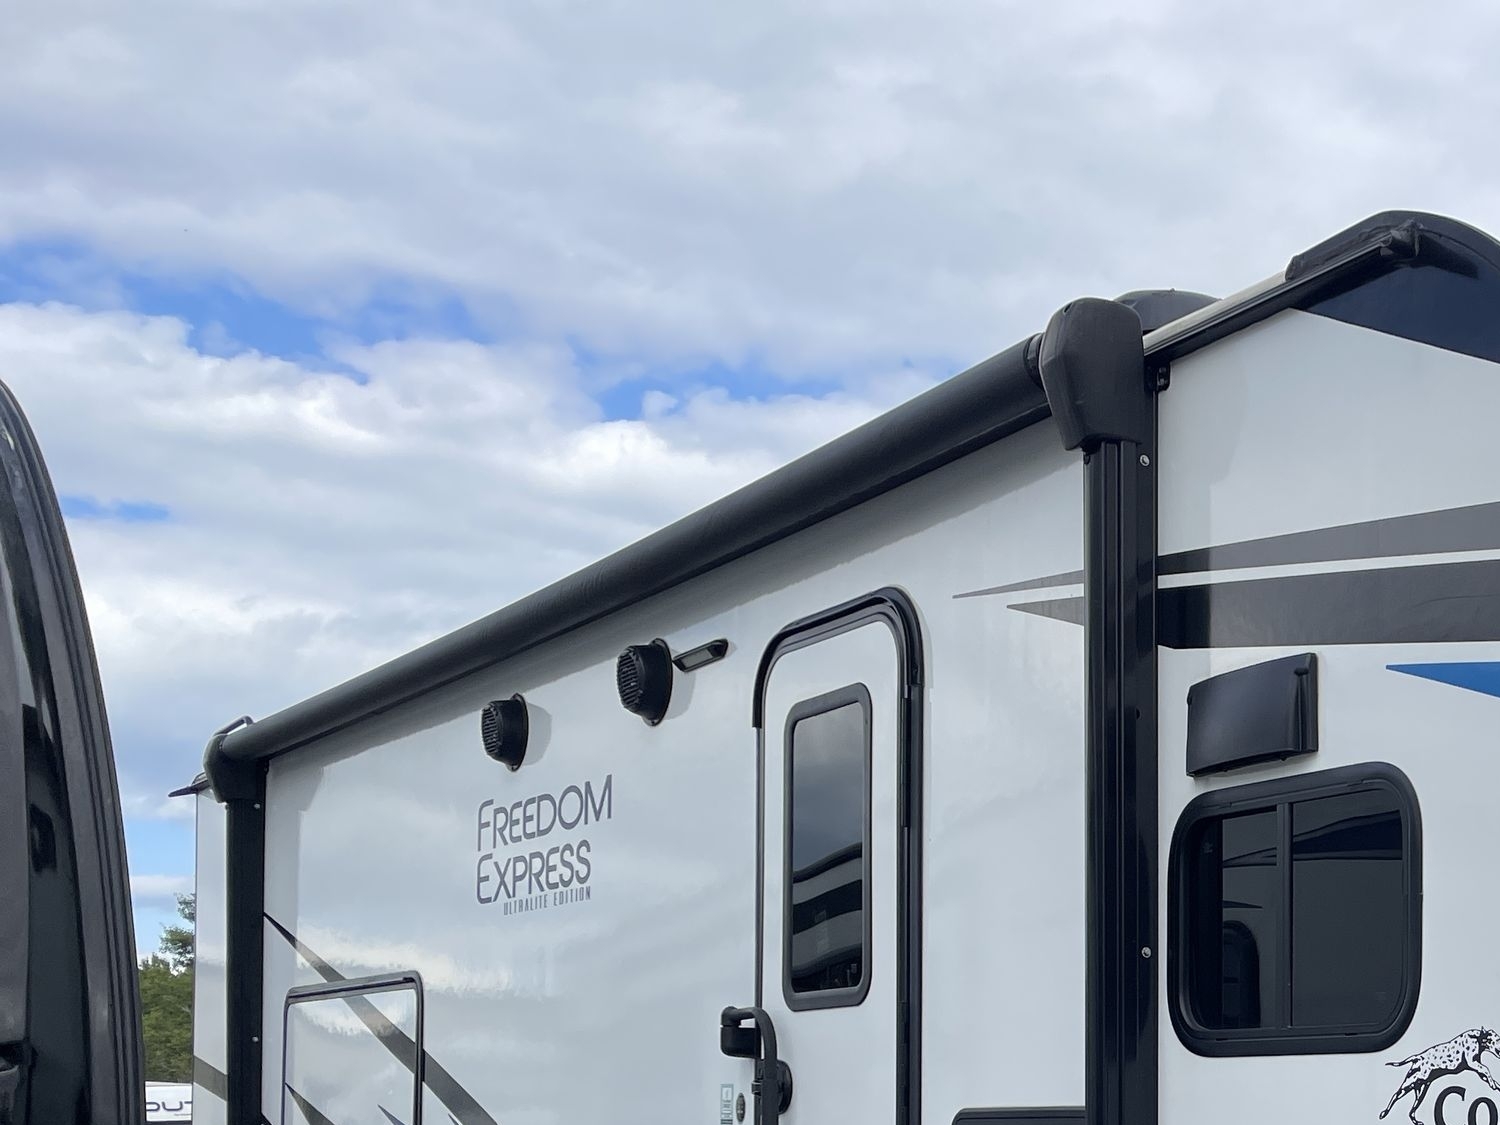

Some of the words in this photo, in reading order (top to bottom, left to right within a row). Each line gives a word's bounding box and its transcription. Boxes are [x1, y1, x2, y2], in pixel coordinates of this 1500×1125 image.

[477, 774, 612, 851] FREEDOM
[476, 839, 591, 904] EXPRESS
[503, 894, 548, 915] ULTRALITE
[553, 886, 591, 906] EDITION
